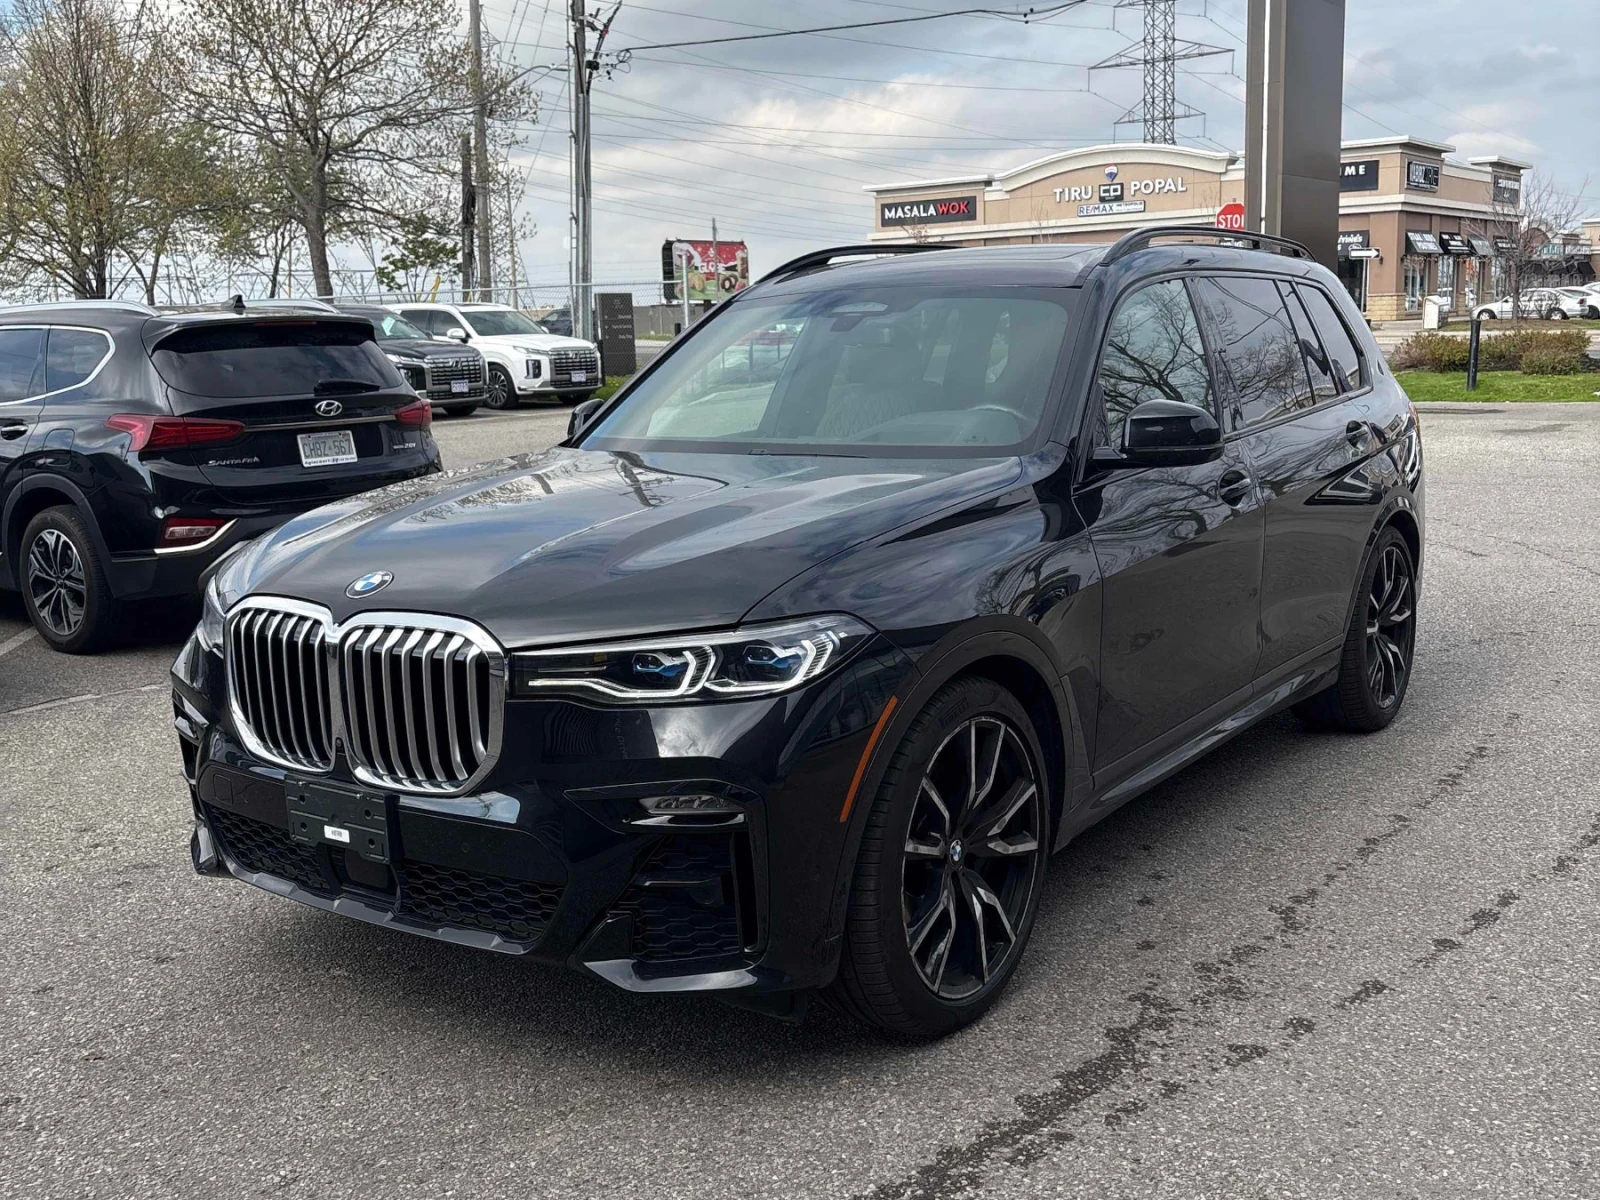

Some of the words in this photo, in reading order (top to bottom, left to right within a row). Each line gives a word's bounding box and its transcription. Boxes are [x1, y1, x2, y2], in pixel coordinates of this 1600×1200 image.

[1053, 185, 1094, 203] TIRU
[1130, 177, 1187, 196] POPAL
[1079, 202, 1114, 215] RE/MAX
